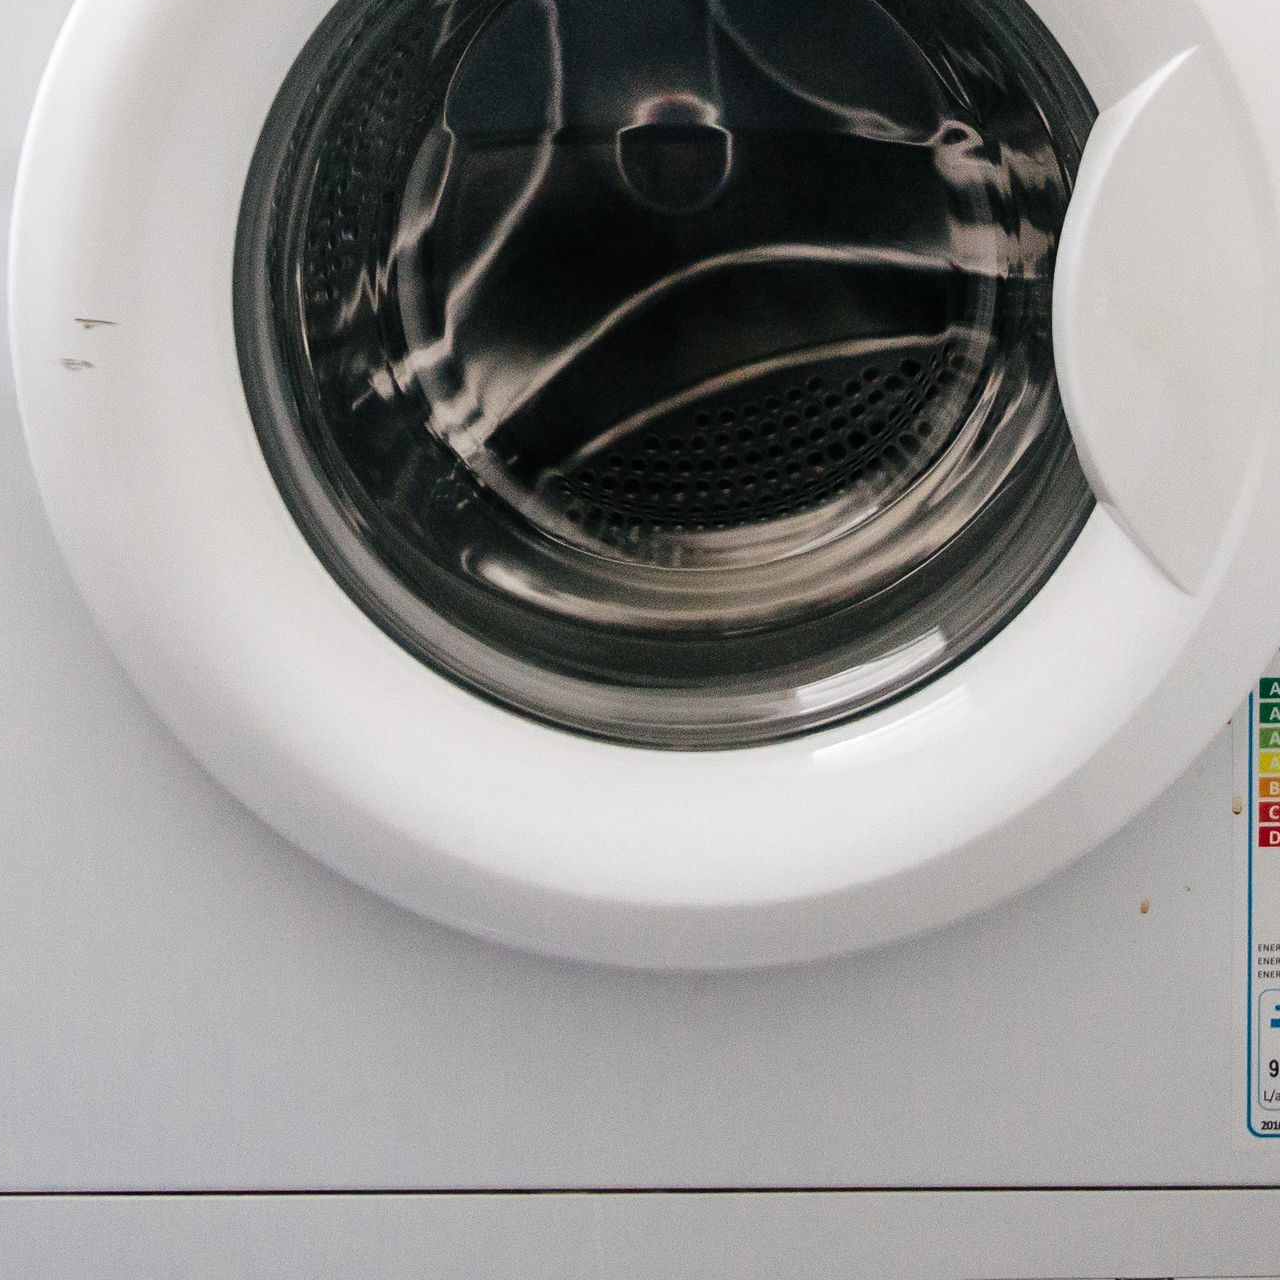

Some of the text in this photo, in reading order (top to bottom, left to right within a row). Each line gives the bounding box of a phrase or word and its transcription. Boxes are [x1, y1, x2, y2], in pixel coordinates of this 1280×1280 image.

[1270, 756, 1280, 770] A
[1269, 781, 1280, 795] B
[1269, 806, 1280, 820] C
[1269, 831, 1280, 844] D
